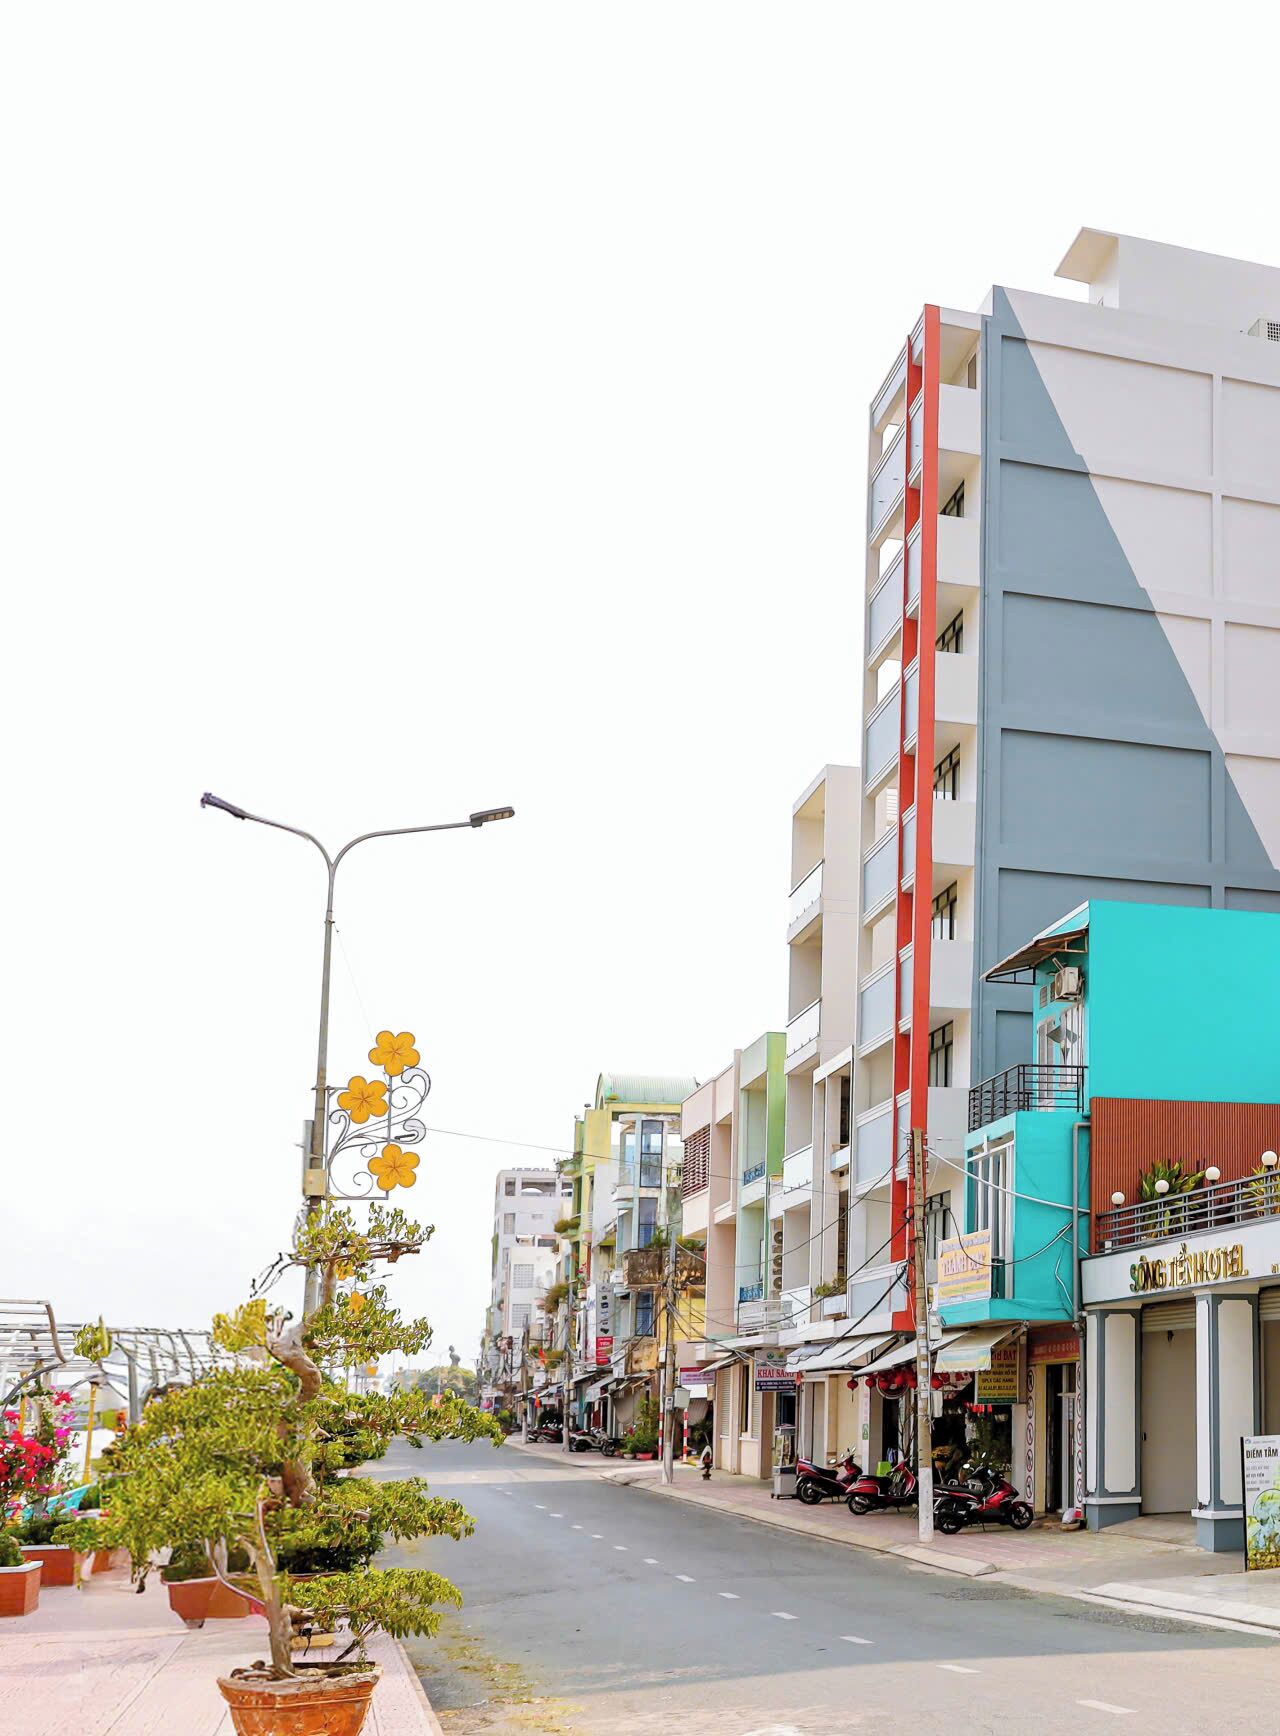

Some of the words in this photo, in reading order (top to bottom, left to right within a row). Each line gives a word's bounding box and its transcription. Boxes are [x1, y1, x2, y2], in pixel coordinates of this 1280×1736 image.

[1130, 1255, 1167, 1292] SÔNG
[1196, 1244, 1249, 1283] HOTEL
[757, 1369, 774, 1378] KHAI
[1264, 1446, 1278, 1458] TÂM
